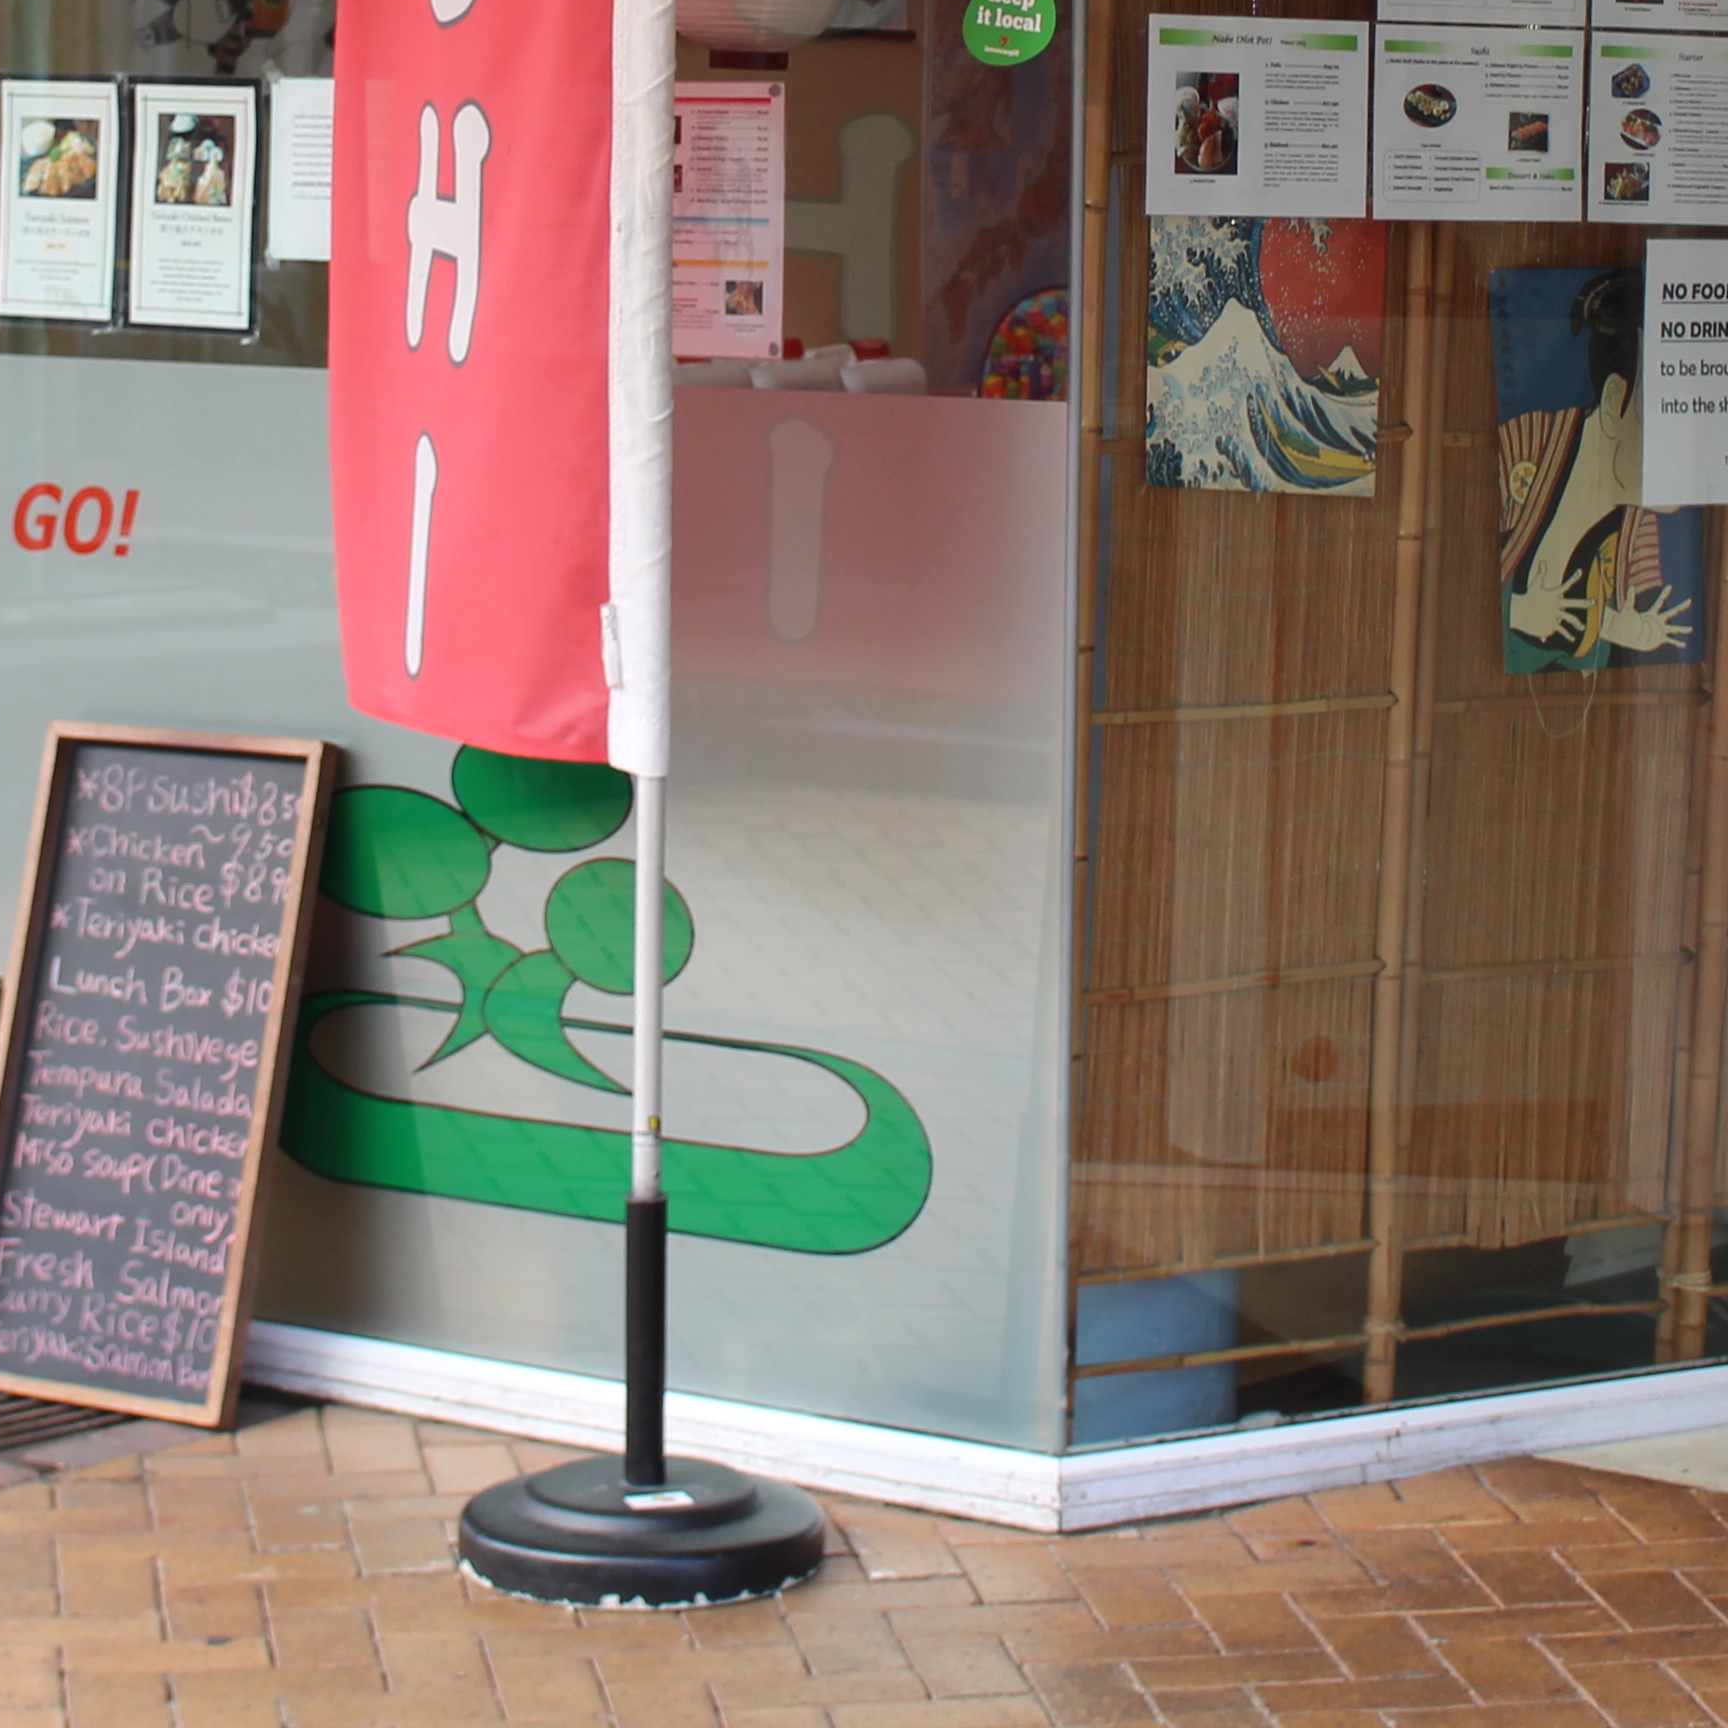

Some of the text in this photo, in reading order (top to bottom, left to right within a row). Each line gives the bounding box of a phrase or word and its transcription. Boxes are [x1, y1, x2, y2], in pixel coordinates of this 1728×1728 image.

[976, 5, 1042, 33] it local
[1661, 283, 1687, 300] NO
[1660, 321, 1686, 338] NO
[1660, 361, 1675, 377] to
[1678, 359, 1697, 377] be
[1661, 398, 1689, 414] into
[1692, 397, 1715, 414] the
[12, 483, 141, 557] GO!
[147, 774, 240, 819] Sushi
[89, 822, 207, 870] Chicken
[88, 866, 127, 894] on
[138, 866, 216, 913] Rice
[74, 896, 187, 960] Teriyaki
[48, 955, 149, 1007] Lunch
[159, 965, 213, 1015] Box
[27, 1049, 147, 1099] Tempura
[21, 1092, 132, 1151] Teriyaki
[1, 1188, 229, 1276] Stewart Island
[79, 1292, 159, 1346] Rice
